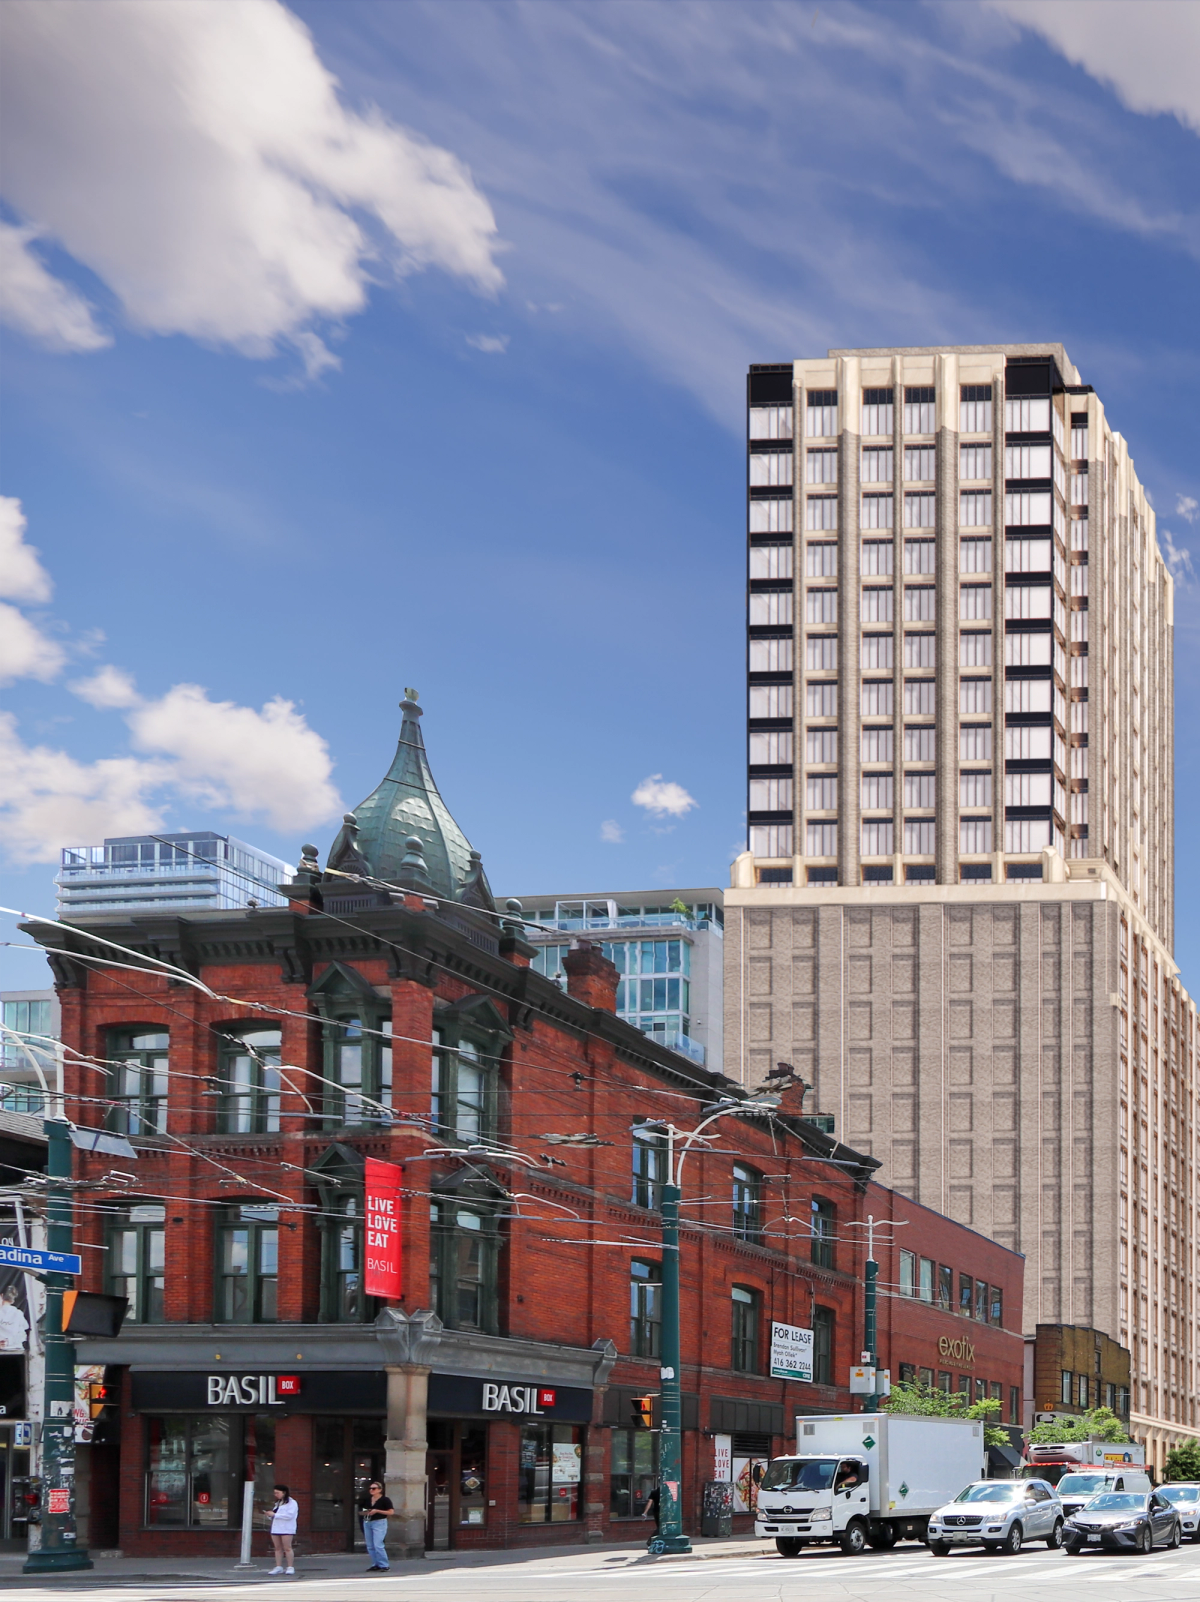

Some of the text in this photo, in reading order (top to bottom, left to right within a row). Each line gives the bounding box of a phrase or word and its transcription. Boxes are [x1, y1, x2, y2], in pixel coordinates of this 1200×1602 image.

[368, 1195, 394, 1215] LIVE
[368, 1213, 398, 1233] LOVE
[368, 1231, 389, 1248] EAT
[48, 1254, 65, 1263] Ave
[367, 1257, 398, 1274] BASIL
[773, 1327, 812, 1344] FOR LEASE
[774, 1358, 811, 1370] 416 362 2244
[207, 1375, 294, 1405] BASIL BOX
[482, 1383, 553, 1414] BASIL BOX
